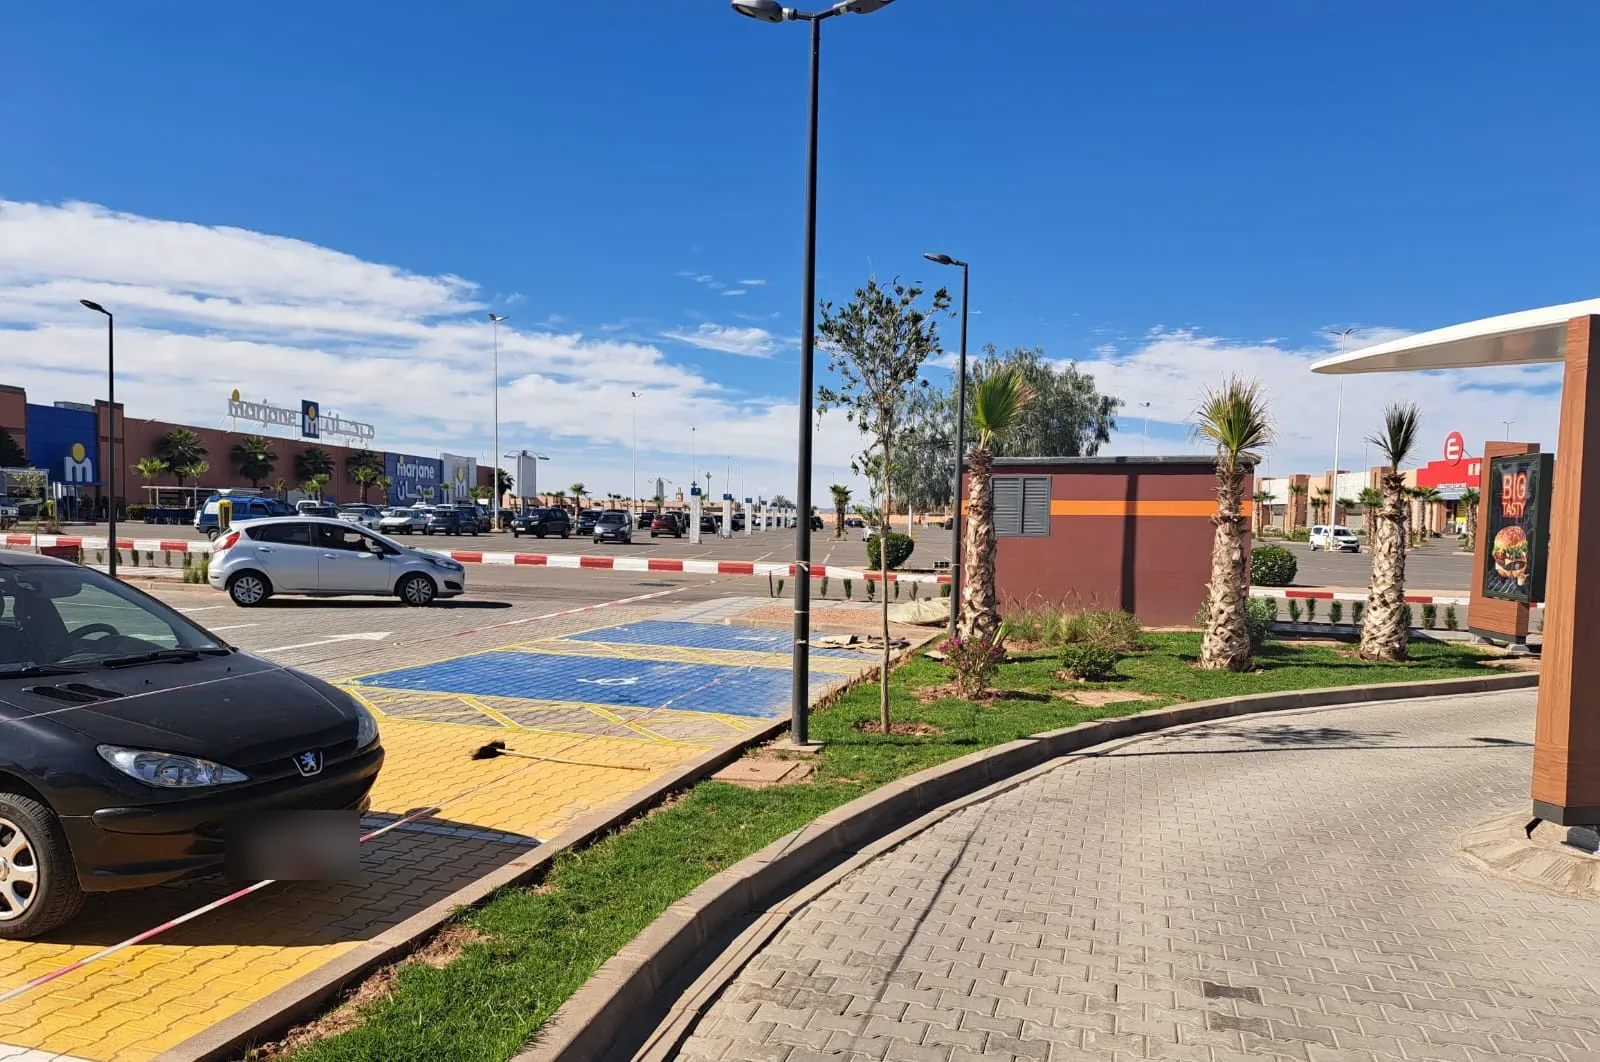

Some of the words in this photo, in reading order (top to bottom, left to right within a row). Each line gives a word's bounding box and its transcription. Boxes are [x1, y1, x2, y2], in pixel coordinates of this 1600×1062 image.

[228, 396, 297, 428] marjane
[397, 460, 435, 482] marjane
[1502, 472, 1527, 500] BIG
[1502, 500, 1526, 518] TASTY
